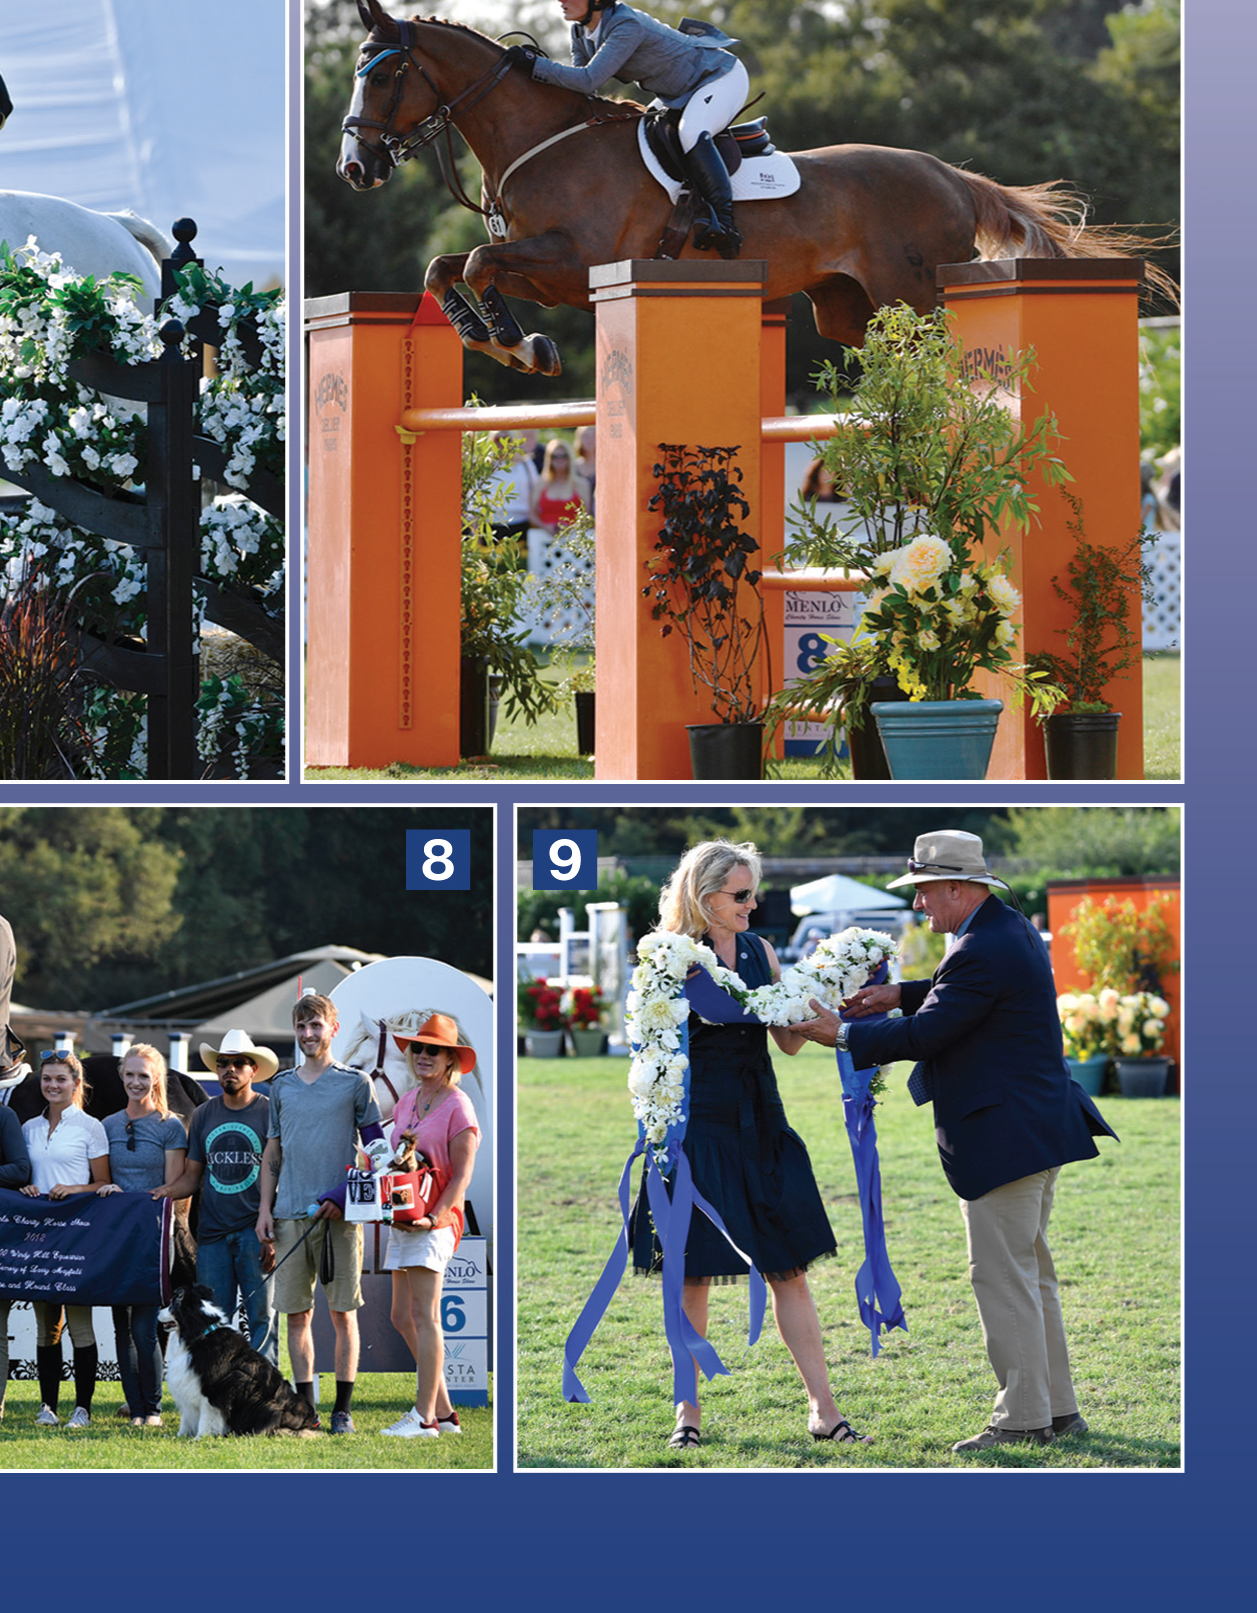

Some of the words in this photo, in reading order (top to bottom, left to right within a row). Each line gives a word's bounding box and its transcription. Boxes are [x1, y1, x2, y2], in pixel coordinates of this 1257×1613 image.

[785, 600, 842, 613] MENLO
[797, 633, 829, 674] 8
[43, 1217, 67, 1227] Horse
[444, 1266, 476, 1278] NLO
[441, 1294, 467, 1333] 6
[447, 1364, 476, 1375] STA
